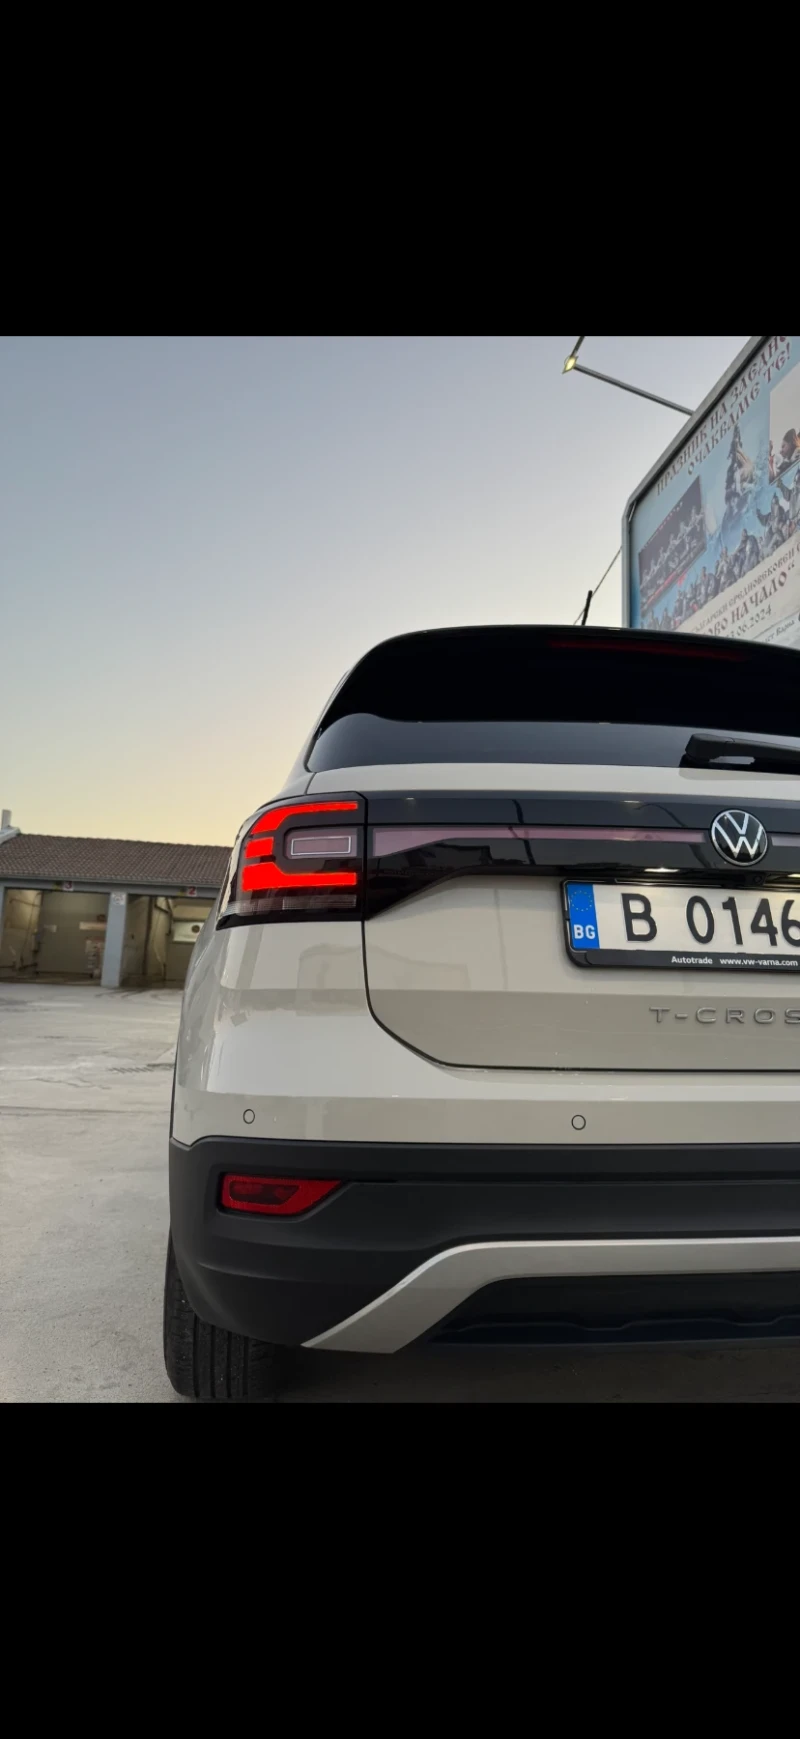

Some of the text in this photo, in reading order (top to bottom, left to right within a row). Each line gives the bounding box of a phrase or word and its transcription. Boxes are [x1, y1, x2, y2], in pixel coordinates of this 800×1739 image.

[710, 402, 727, 431] НА
[573, 924, 596, 940] BG
[686, 896, 800, 947] 0146
[671, 956, 798, 967] Autotrade www.vw-varna.com
